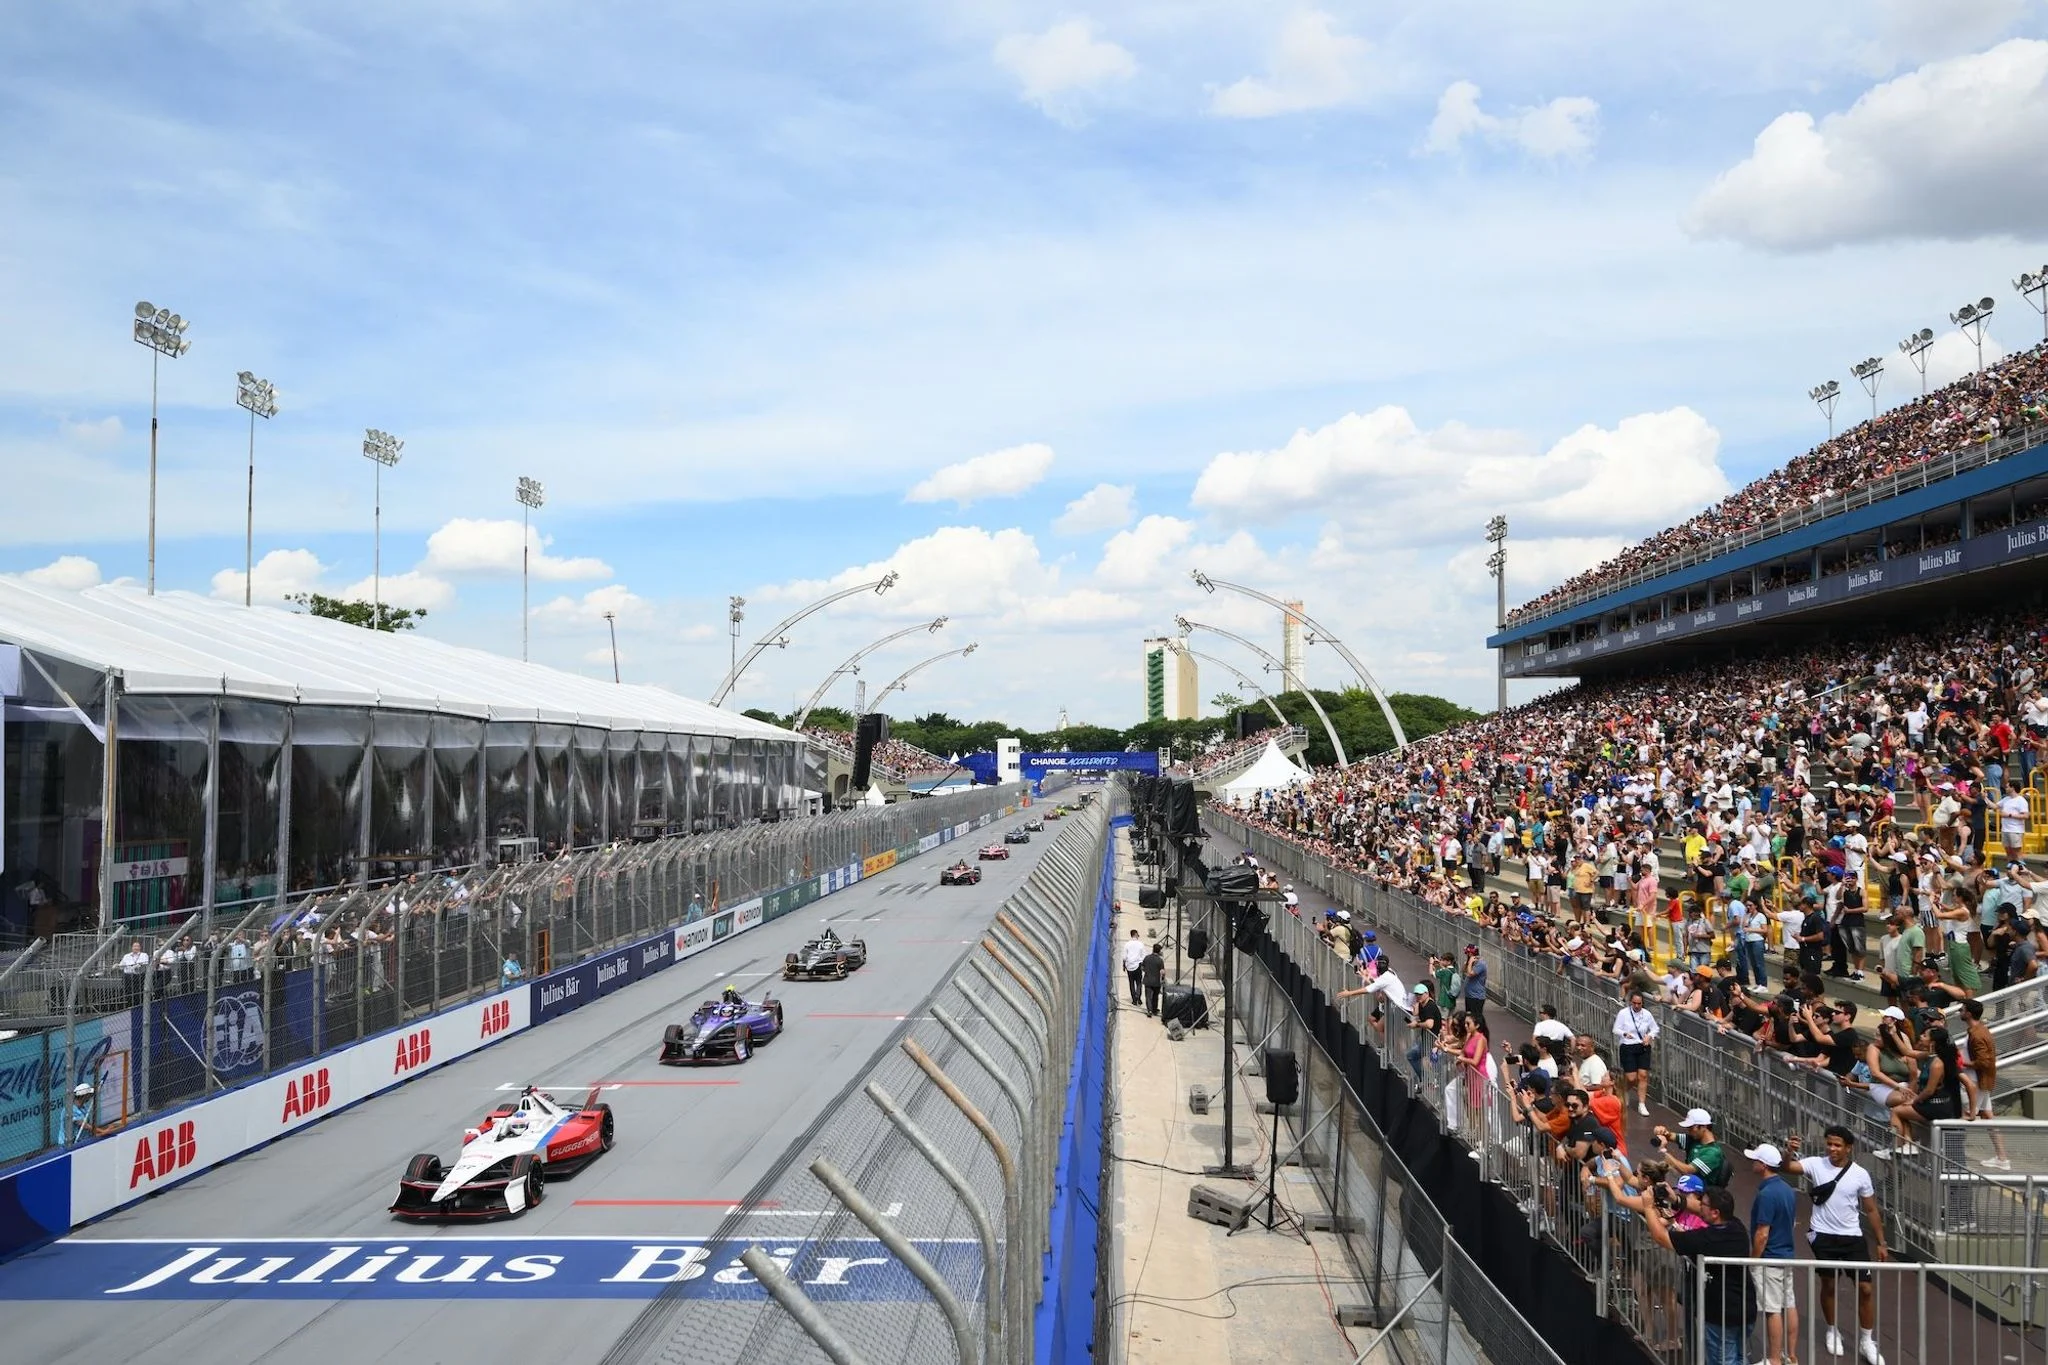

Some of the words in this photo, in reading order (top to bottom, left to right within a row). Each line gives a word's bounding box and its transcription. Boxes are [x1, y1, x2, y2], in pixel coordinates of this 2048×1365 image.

[2007, 531, 2037, 554] Julius
[1919, 556, 1944, 575] Julius
[1945, 549, 1962, 566] Bär
[1848, 574, 1868, 591] Julius
[1869, 569, 1884, 584] Bär
[1737, 603, 1752, 618] Julius
[1752, 600, 1763, 612] Bär
[1787, 590, 1805, 607] Julius
[1806, 586, 1819, 599] Bär
[643, 946, 659, 968] Julius
[660, 940, 670, 958] Bär
[597, 962, 616, 989] Julius
[616, 957, 629, 976] Bär
[540, 983, 564, 1012] Julius
[565, 976, 580, 998] Bär
[481, 1000, 510, 1039] ABB
[394, 1029, 432, 1075] ABB
[282, 1067, 331, 1124] ABB
[130, 1120, 197, 1190] ABB
[103, 1246, 565, 1295] Julius
[600, 1245, 890, 1285] Bär
